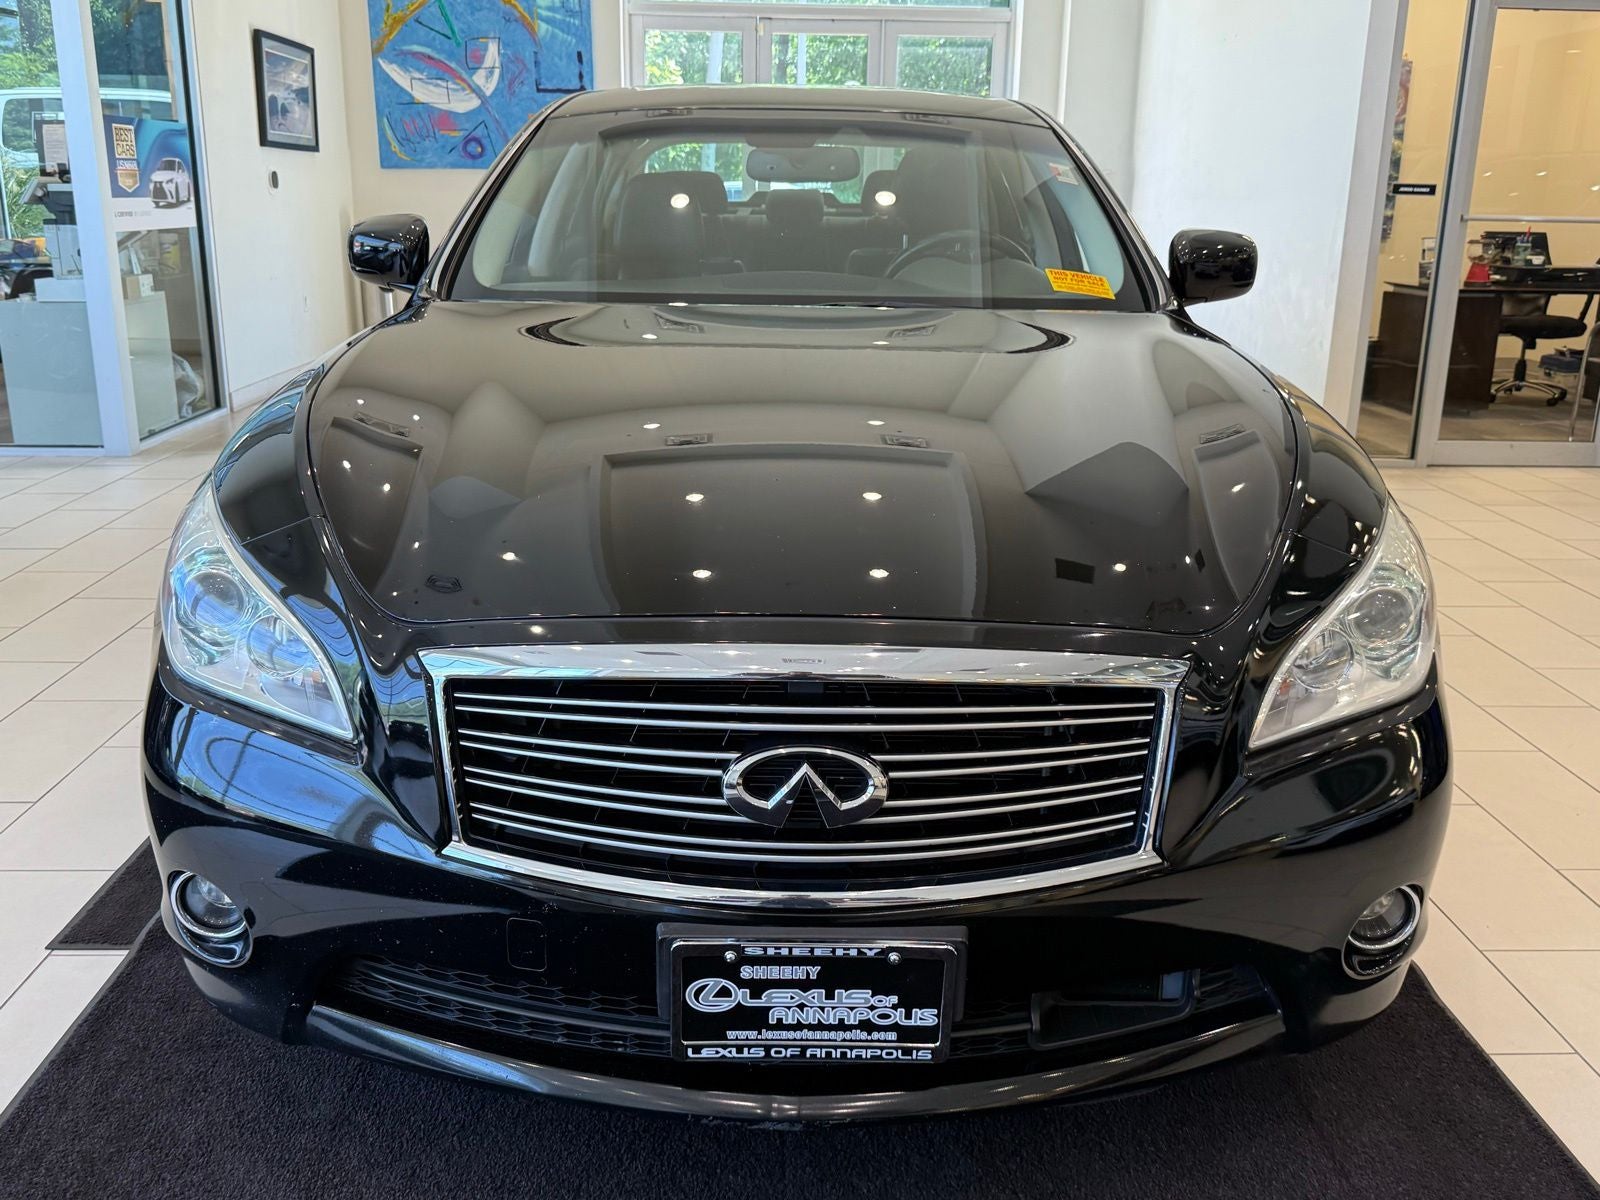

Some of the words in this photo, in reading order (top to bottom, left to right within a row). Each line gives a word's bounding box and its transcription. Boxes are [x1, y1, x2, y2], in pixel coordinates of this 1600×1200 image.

[114, 126, 134, 143] BEST
[116, 142, 135, 157] CARS
[1071, 273, 1105, 282] VEHICLE
[744, 947, 881, 956] SHEEHY
[740, 965, 821, 979] SHEEHY
[739, 989, 872, 1007] LEXUS
[769, 1007, 938, 1026] ANNAPOLIS
[726, 1029, 898, 1041] www.lexusofannapolis.com
[687, 1047, 765, 1058] LEXUS
[770, 1047, 802, 1058] OF
[806, 1048, 932, 1060] ANNAPOLIS
